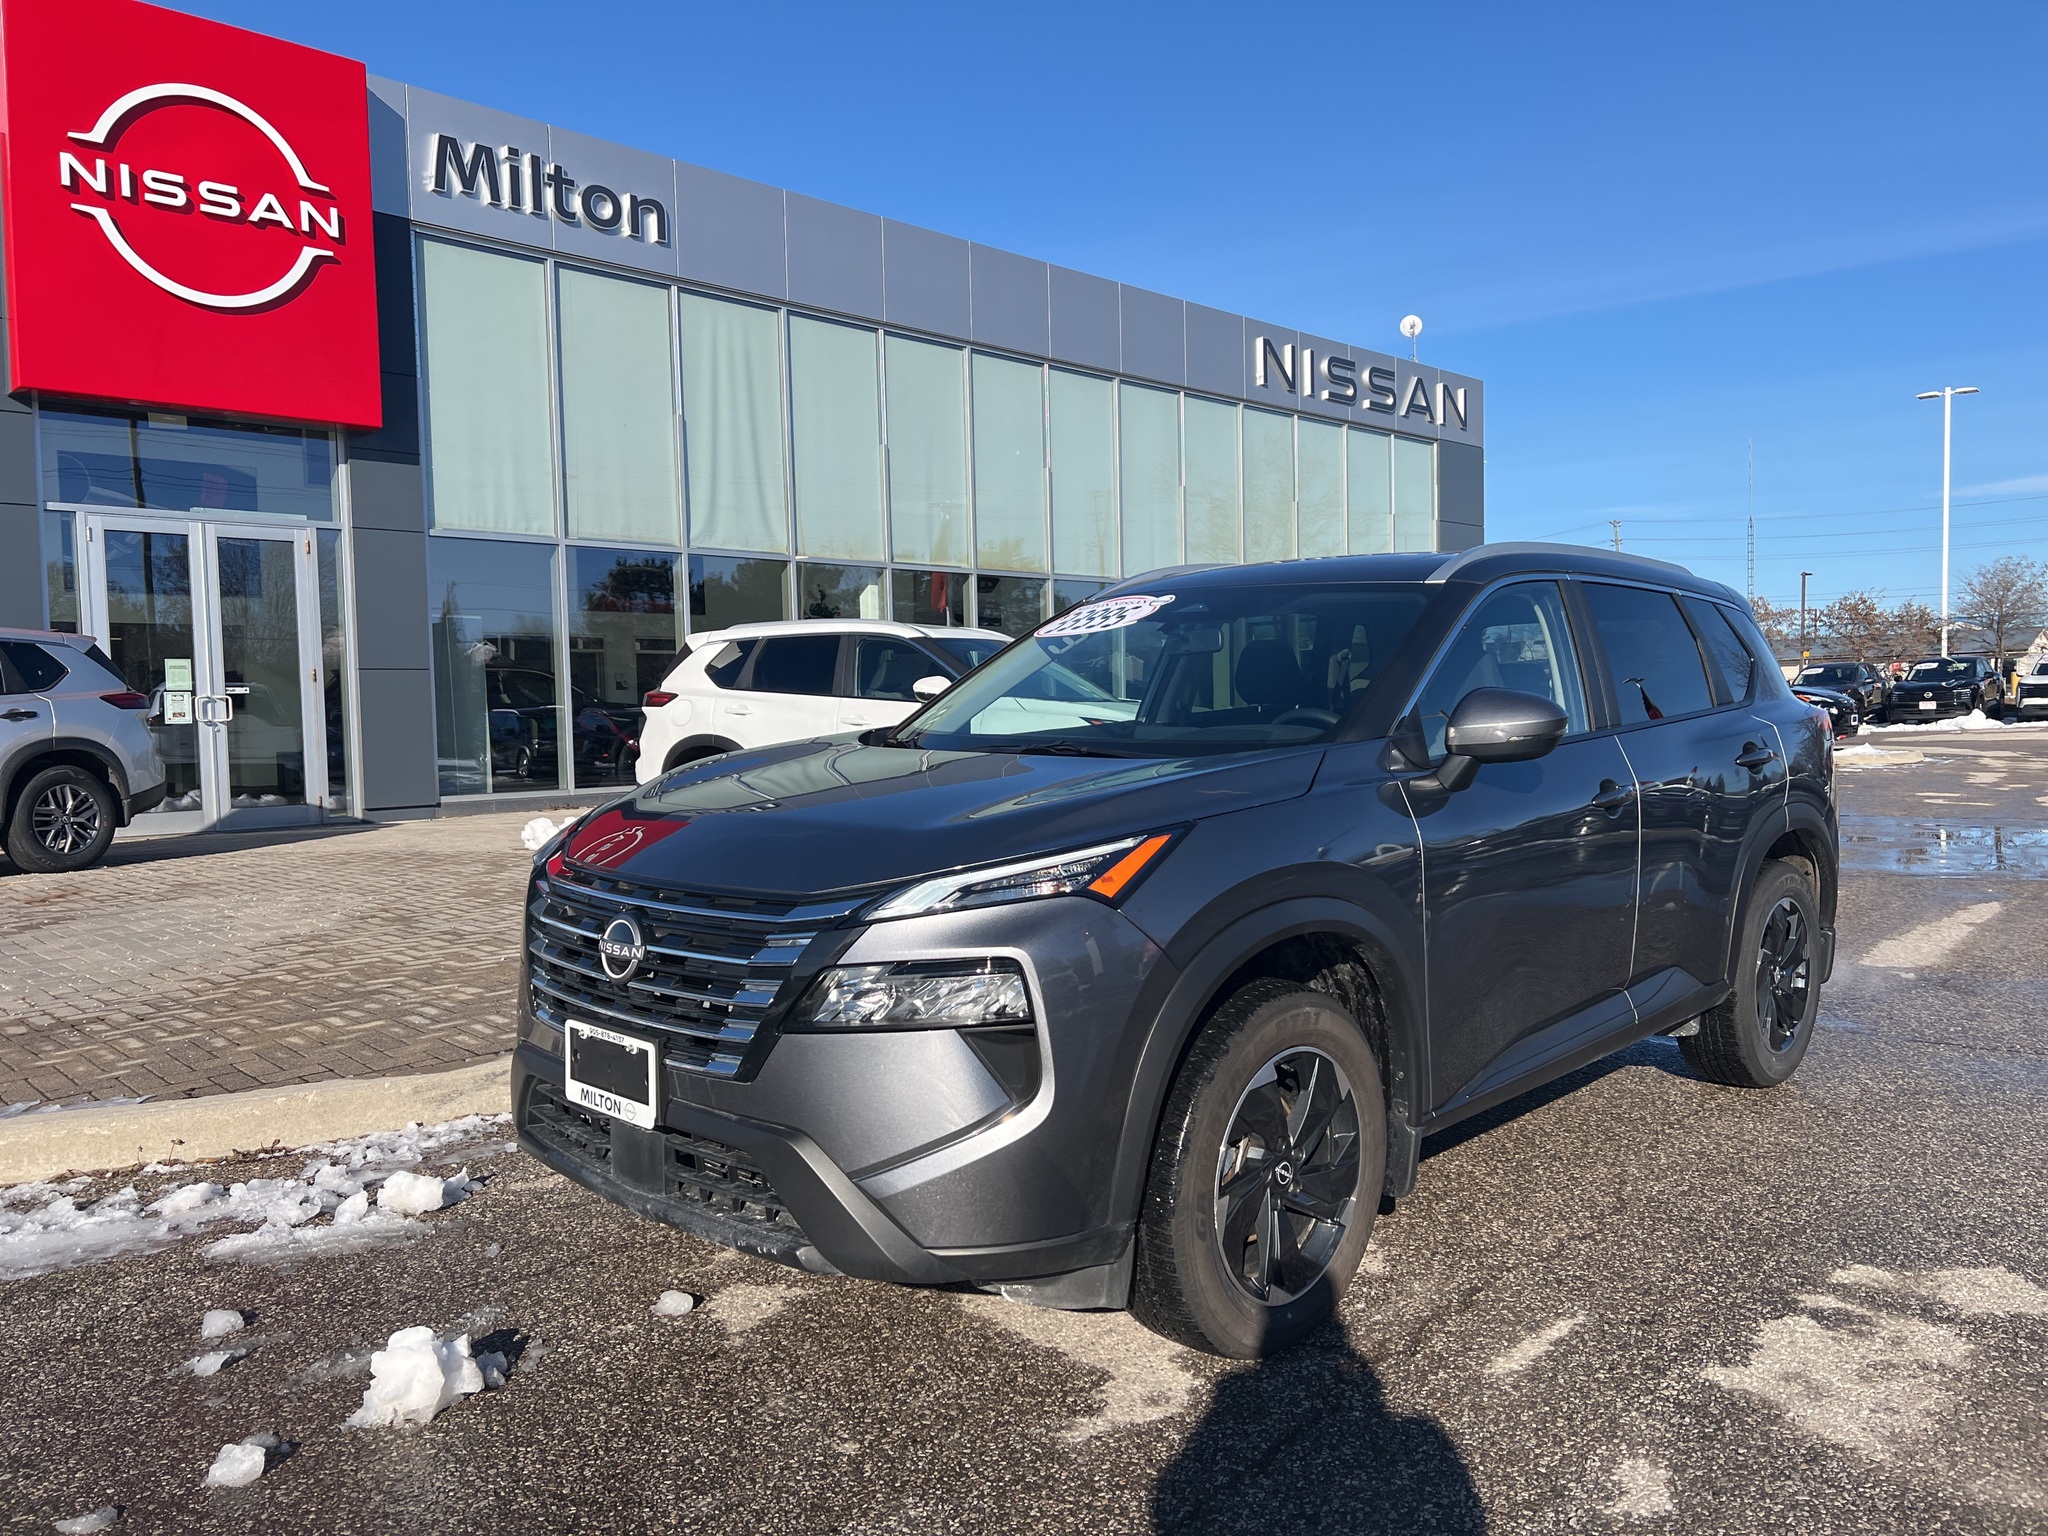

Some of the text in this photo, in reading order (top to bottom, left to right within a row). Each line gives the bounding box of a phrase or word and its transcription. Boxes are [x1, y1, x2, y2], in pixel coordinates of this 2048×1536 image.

[59, 151, 342, 240] NISSAN
[427, 132, 669, 245] Milton
[1255, 336, 1468, 431] NISSAN
[599, 939, 645, 960] NISSAN
[580, 1087, 622, 1116] MILTON
